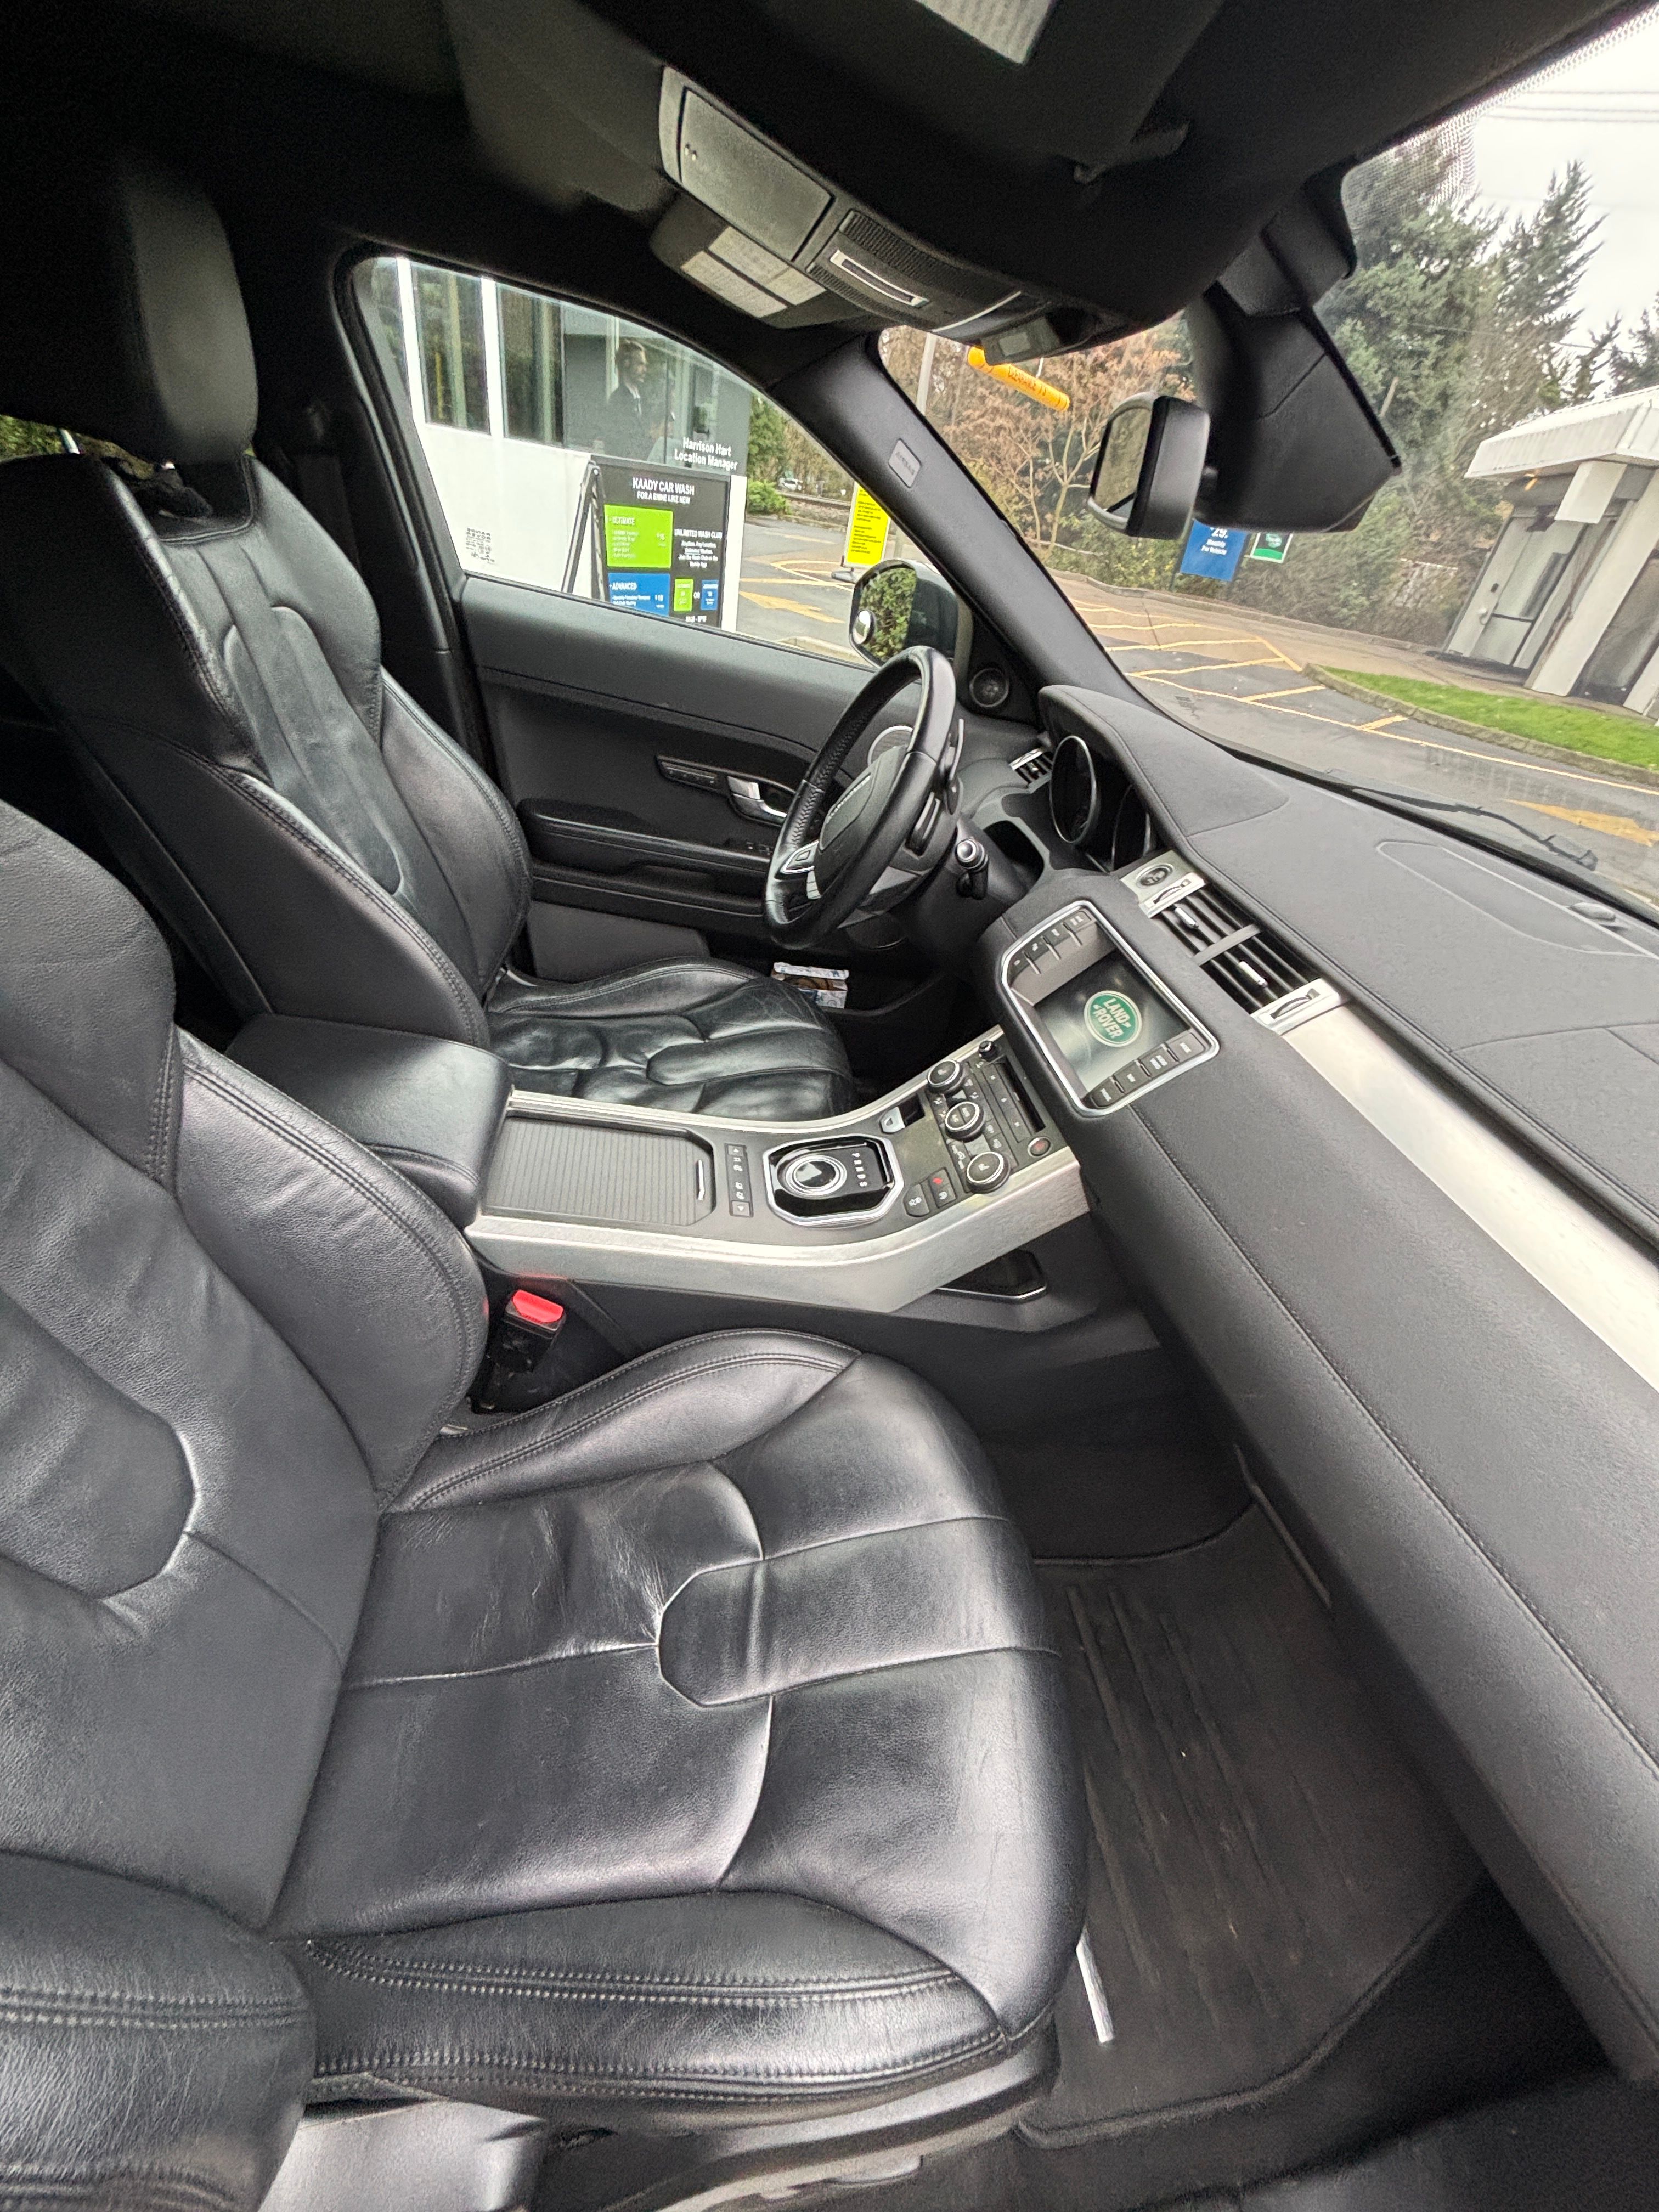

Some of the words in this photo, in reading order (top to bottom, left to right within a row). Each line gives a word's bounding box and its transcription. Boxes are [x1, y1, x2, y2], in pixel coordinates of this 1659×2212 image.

[682, 437, 714, 454] Harrison
[715, 443, 732, 458] Hart
[674, 448, 707, 465] Location
[707, 454, 738, 472] Manager
[633, 477, 658, 492] KAADY
[658, 481, 675, 493] CAR
[675, 483, 695, 496] WASH
[637, 490, 648, 500] FOR
[648, 492, 653, 500] A
[653, 493, 668, 503] SHINE
[668, 494, 679, 504] LIKE
[679, 496, 691, 505] NEW
[612, 582, 637, 590] ADVANCED
[1103, 998, 1131, 1024] LAND
[1092, 1008, 1124, 1039] ROVER
